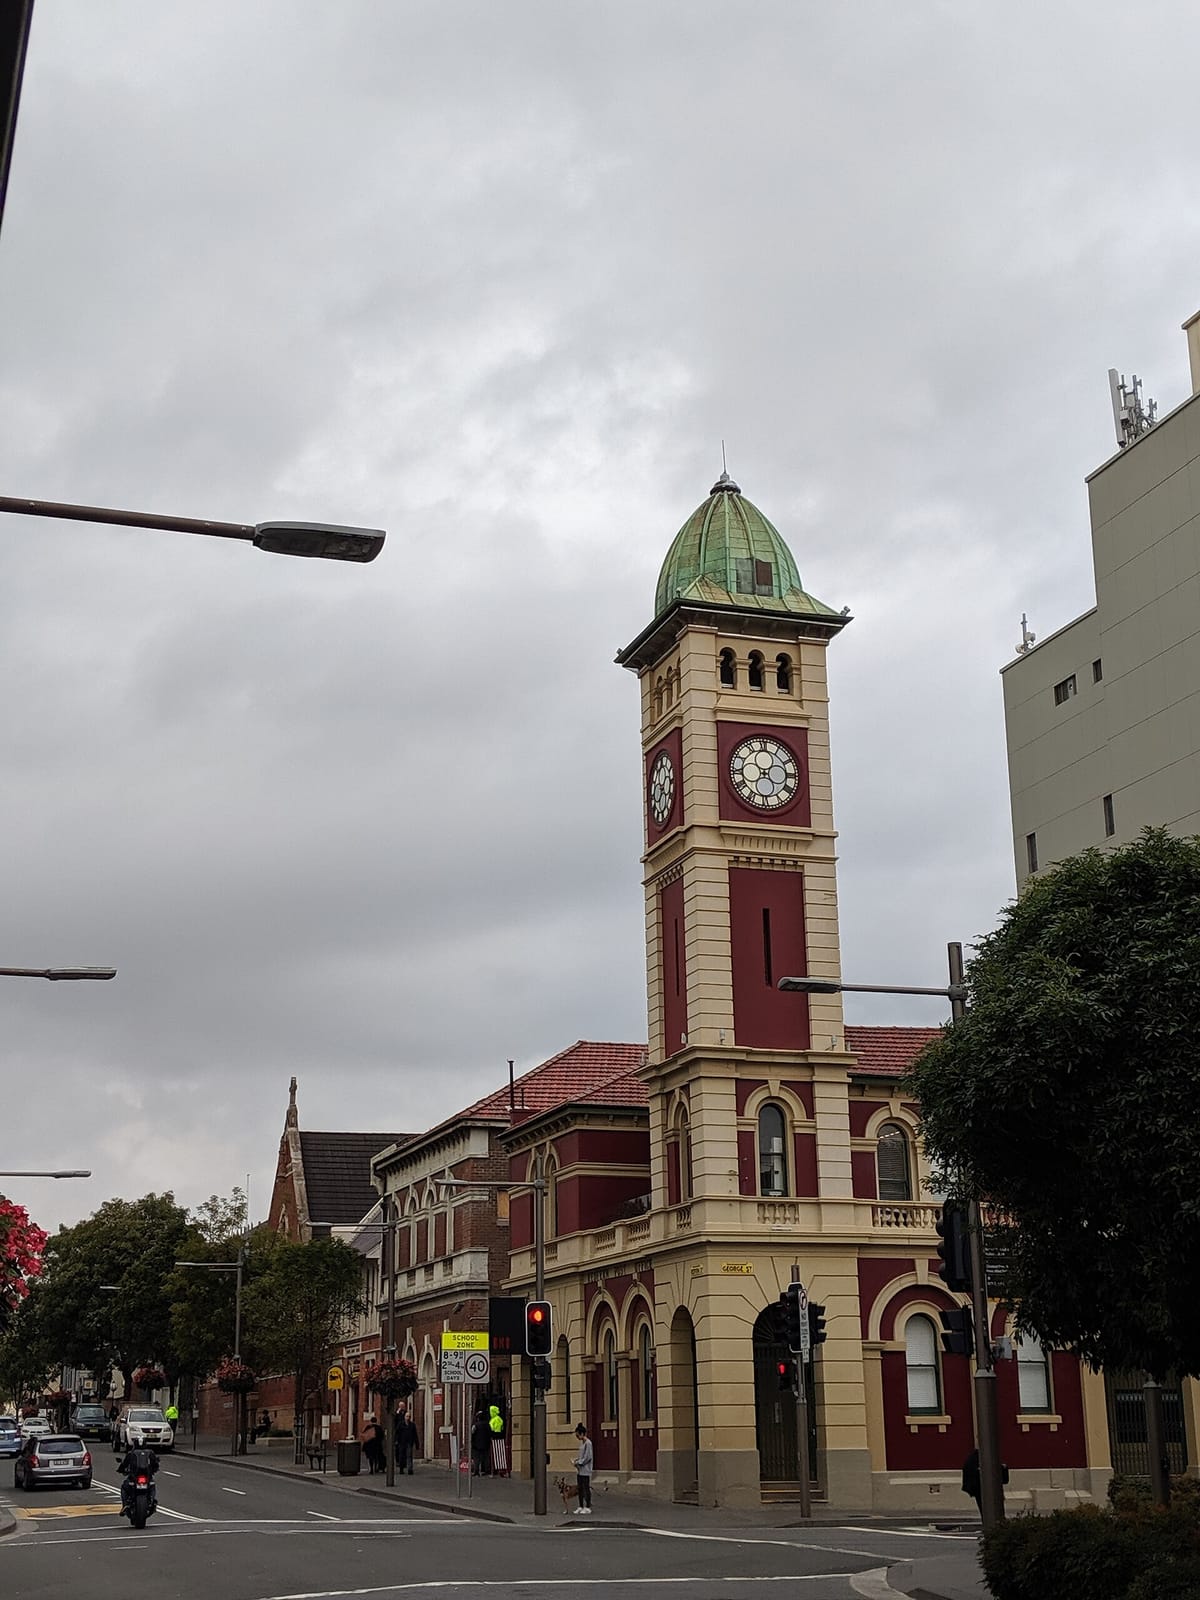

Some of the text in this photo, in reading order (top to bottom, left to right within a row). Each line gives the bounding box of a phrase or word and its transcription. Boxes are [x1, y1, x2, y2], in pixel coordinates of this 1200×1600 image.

[722, 1265, 752, 1273] GEORGE ST
[469, 1360, 485, 1372] 40
